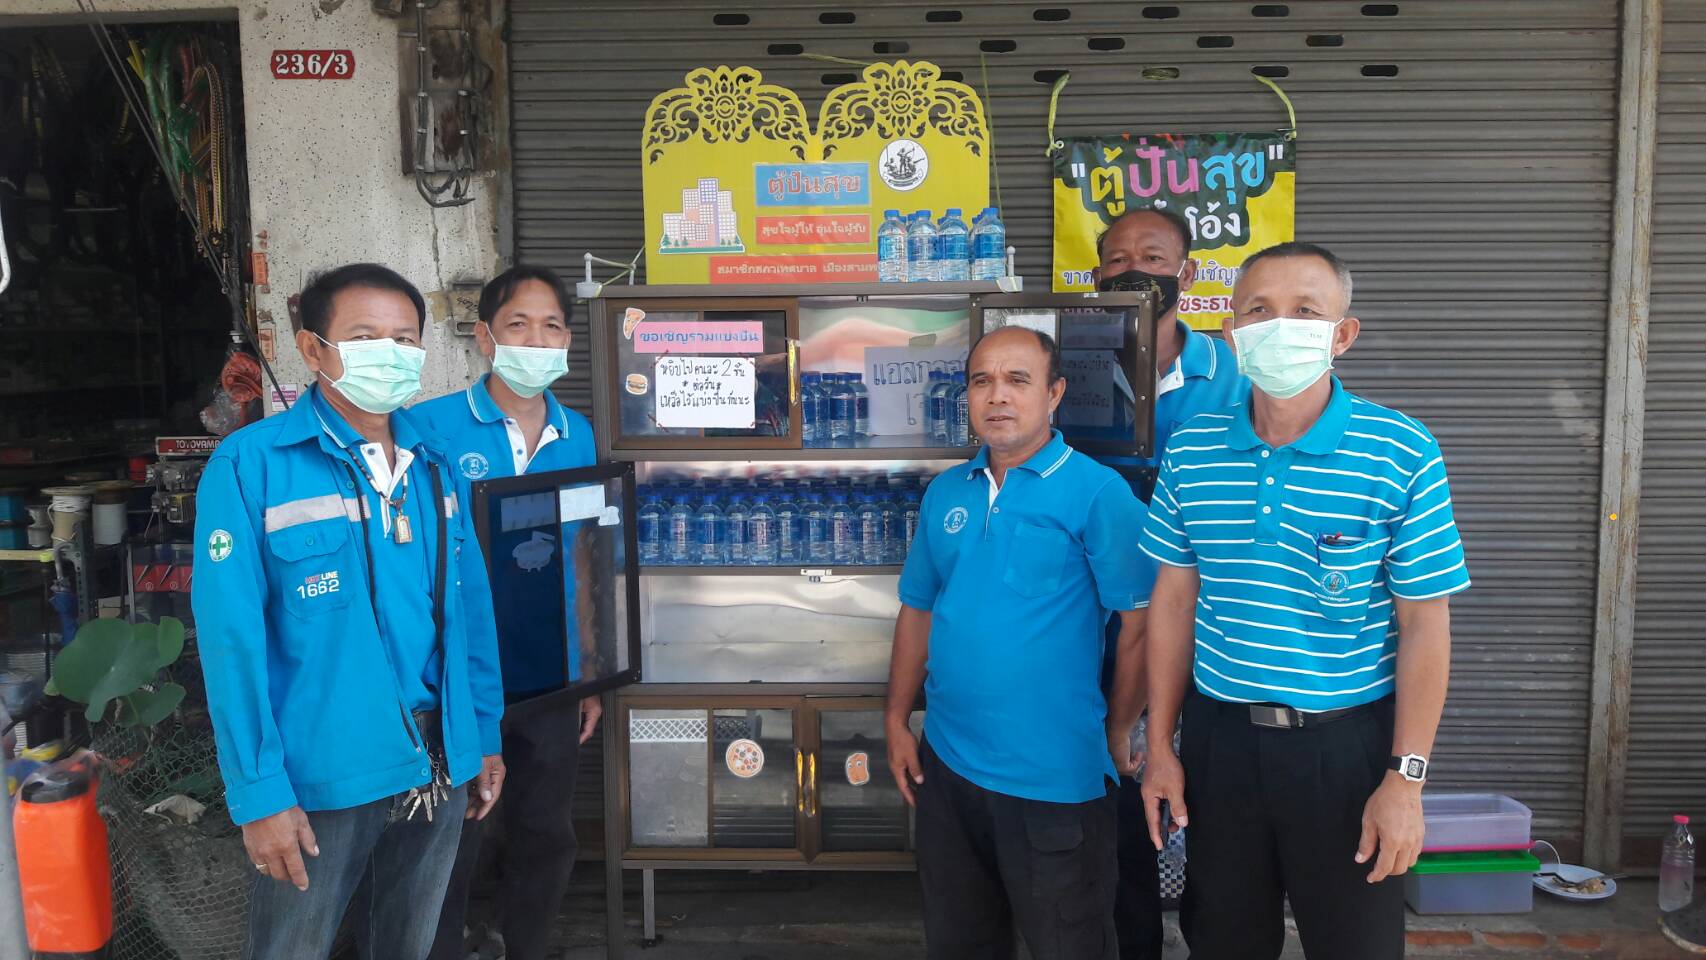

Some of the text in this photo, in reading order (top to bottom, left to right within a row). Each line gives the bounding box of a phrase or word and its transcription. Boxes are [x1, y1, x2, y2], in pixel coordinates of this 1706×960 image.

[275, 50, 349, 77] 236/3
[768, 169, 862, 201] ตู้ปันสุข
[296, 578, 341, 600] 1662
